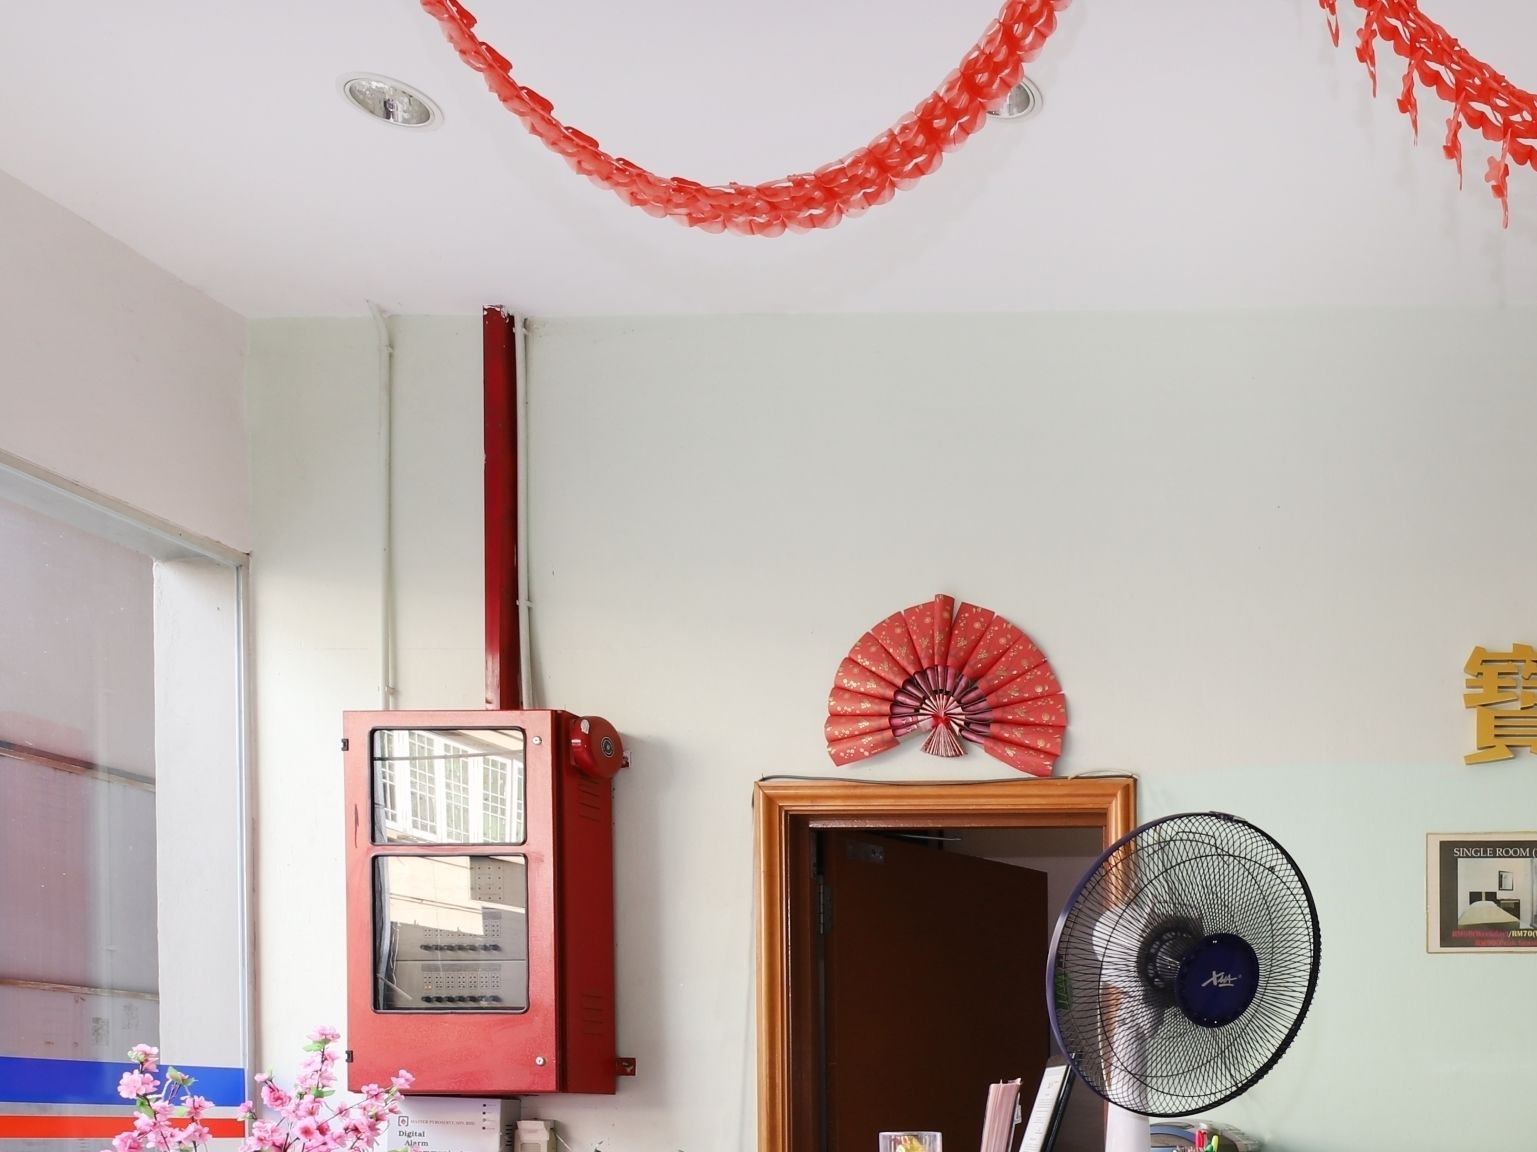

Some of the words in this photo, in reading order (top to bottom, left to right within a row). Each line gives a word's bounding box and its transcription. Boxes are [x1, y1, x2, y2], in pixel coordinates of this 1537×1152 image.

[1453, 847, 1494, 858] SINGLE
[1496, 847, 1530, 857] ROOM
[398, 1130, 425, 1138] Digital
[404, 1139, 429, 1147] Alarm
